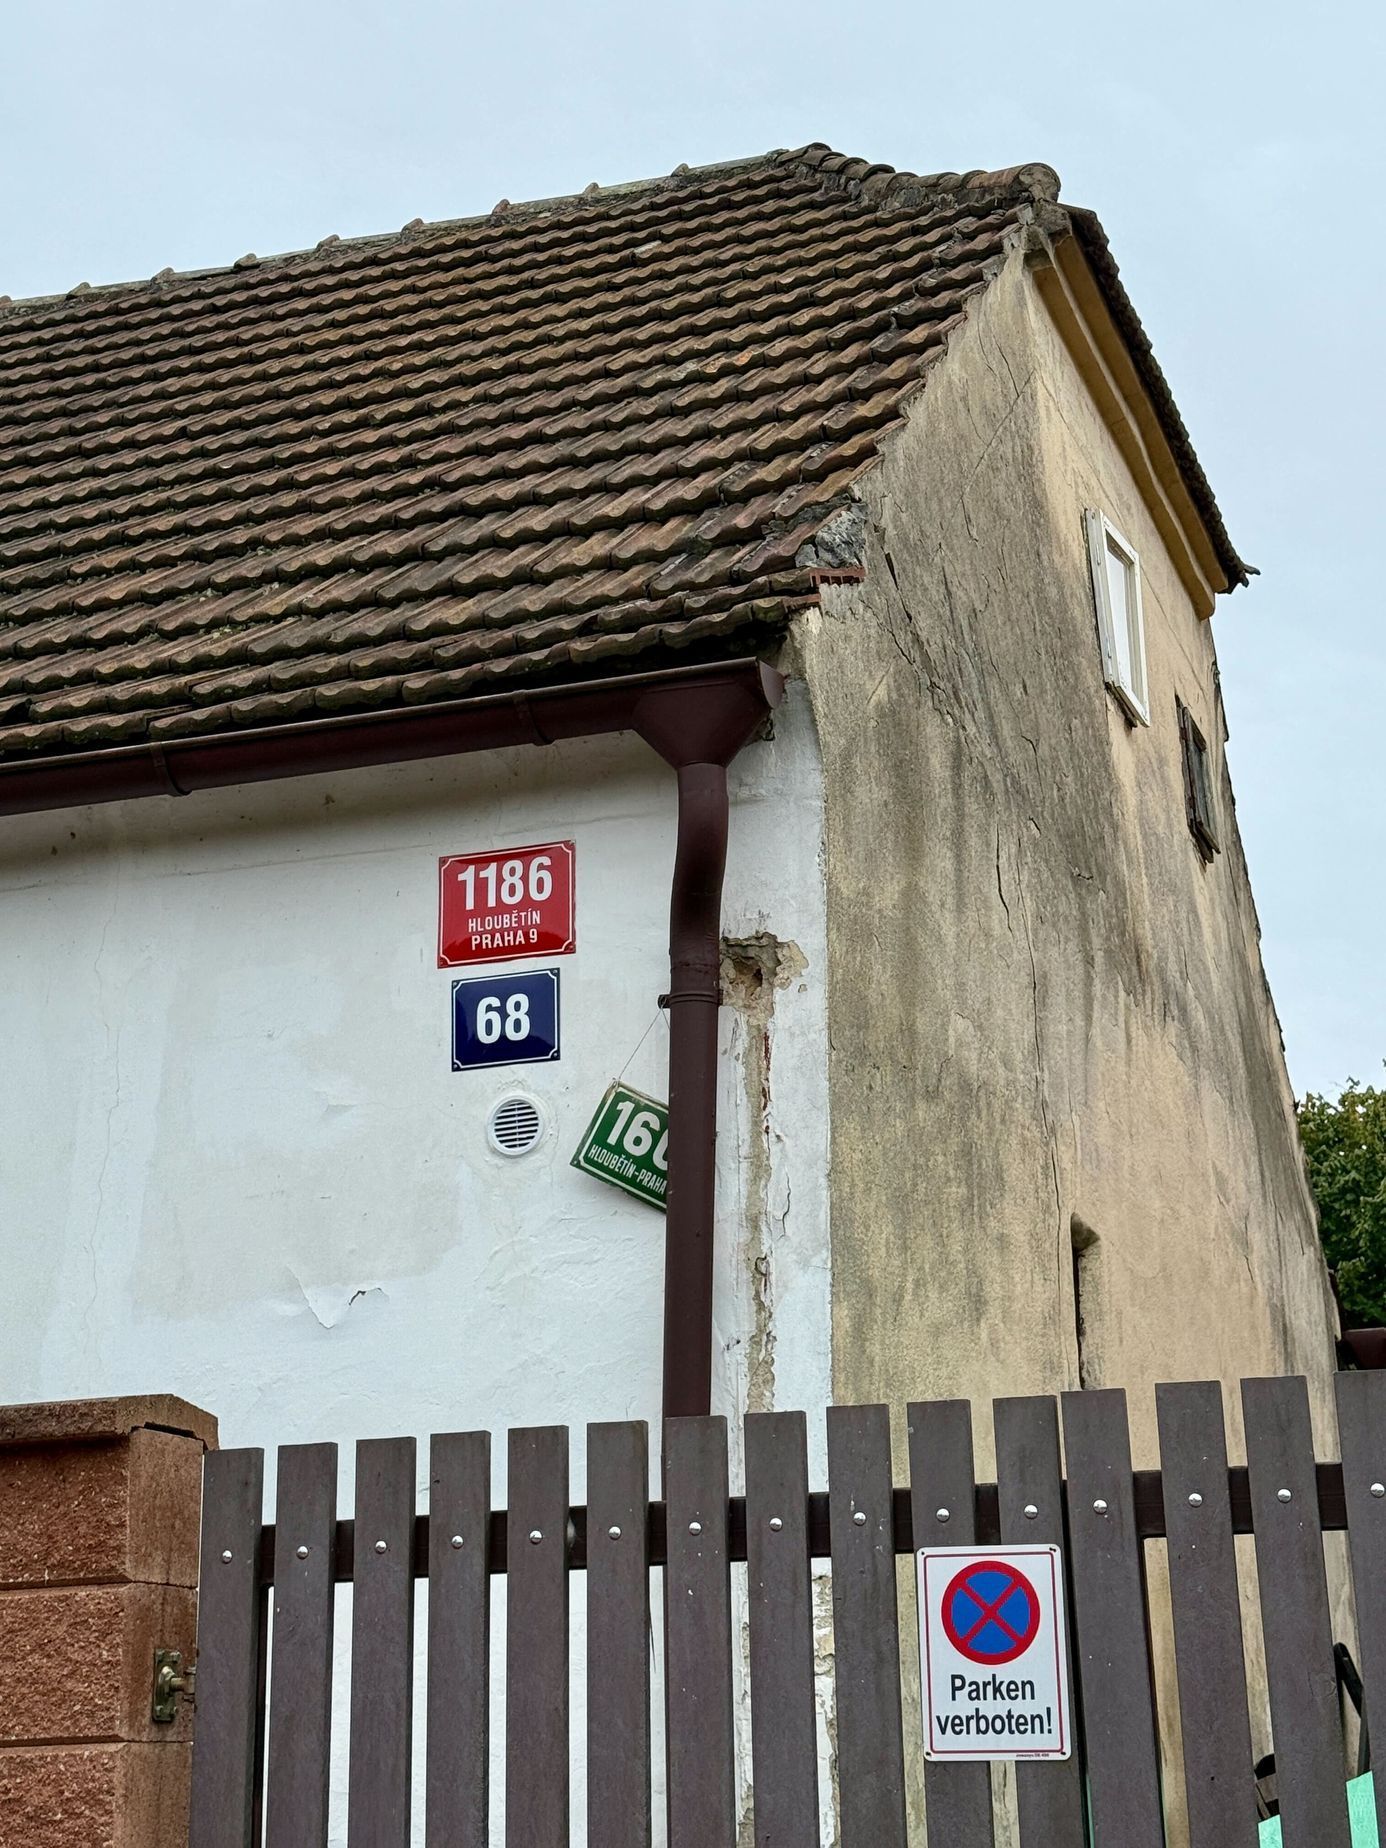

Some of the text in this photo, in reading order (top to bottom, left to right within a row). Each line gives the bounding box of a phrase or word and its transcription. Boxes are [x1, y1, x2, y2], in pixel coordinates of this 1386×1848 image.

[457, 856, 552, 910] 1186
[468, 908, 541, 933] HLOUBĚTÍN
[471, 931, 538, 951] PRAHA 9
[476, 993, 531, 1044] 68
[950, 1673, 1036, 1702] Parken
[936, 1706, 1053, 1736] verboten!
